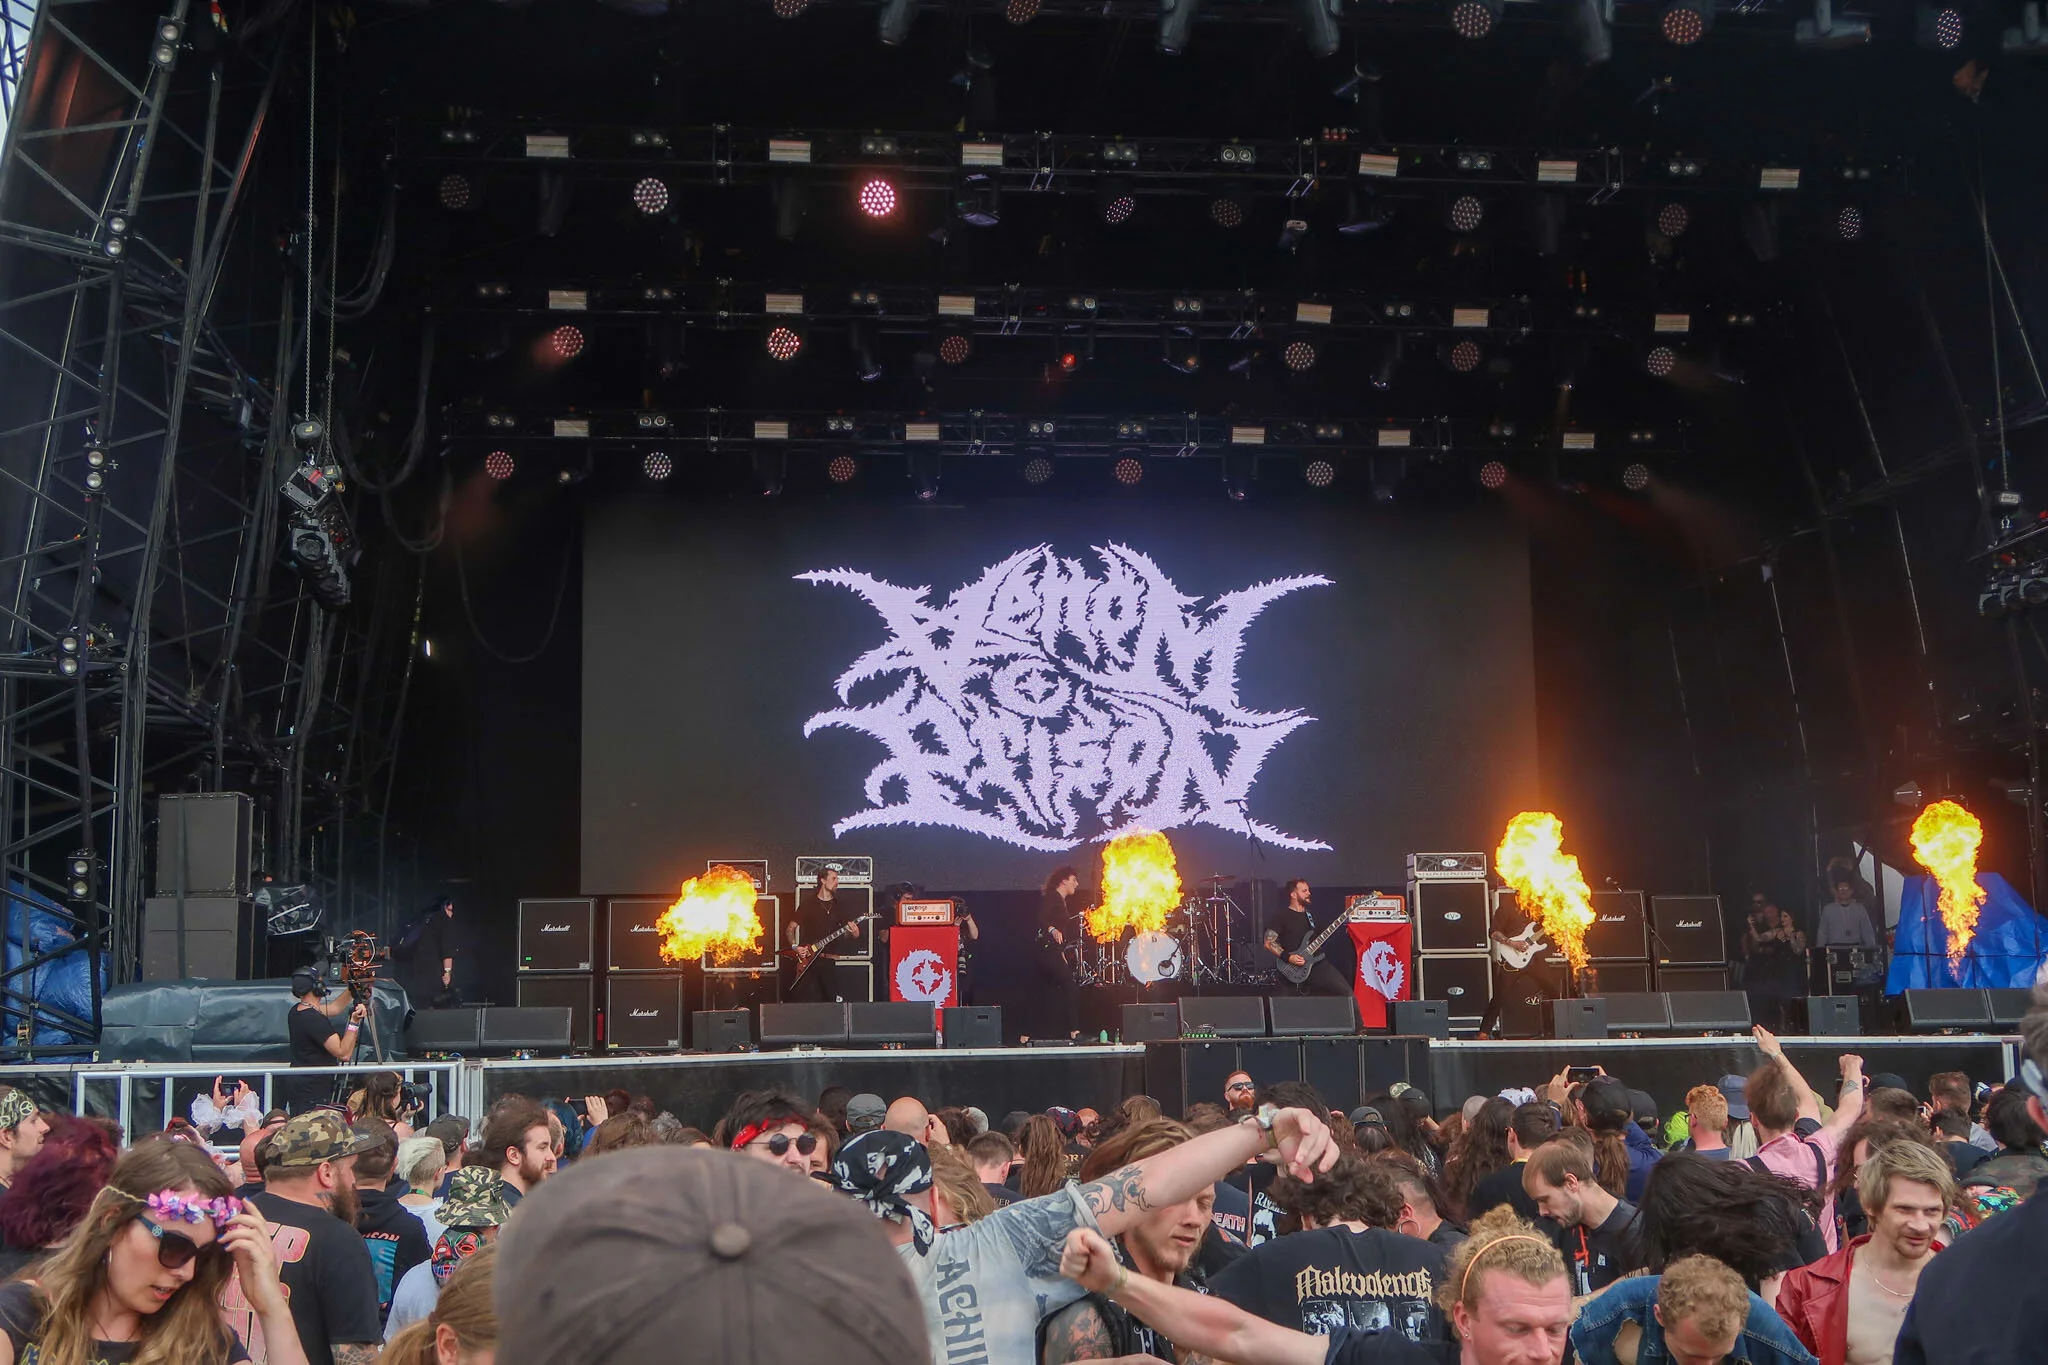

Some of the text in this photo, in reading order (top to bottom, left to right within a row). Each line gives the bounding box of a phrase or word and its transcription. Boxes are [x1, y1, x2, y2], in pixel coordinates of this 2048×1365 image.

[1598, 914, 1626, 922] Marshall
[541, 923, 571, 932] Marshall
[630, 924, 660, 933] Marsha
[1676, 920, 1703, 928] Marshall
[629, 1008, 659, 1017] Marshall
[1211, 1212, 1246, 1233] EATH
[936, 1256, 989, 1365] ACHI
